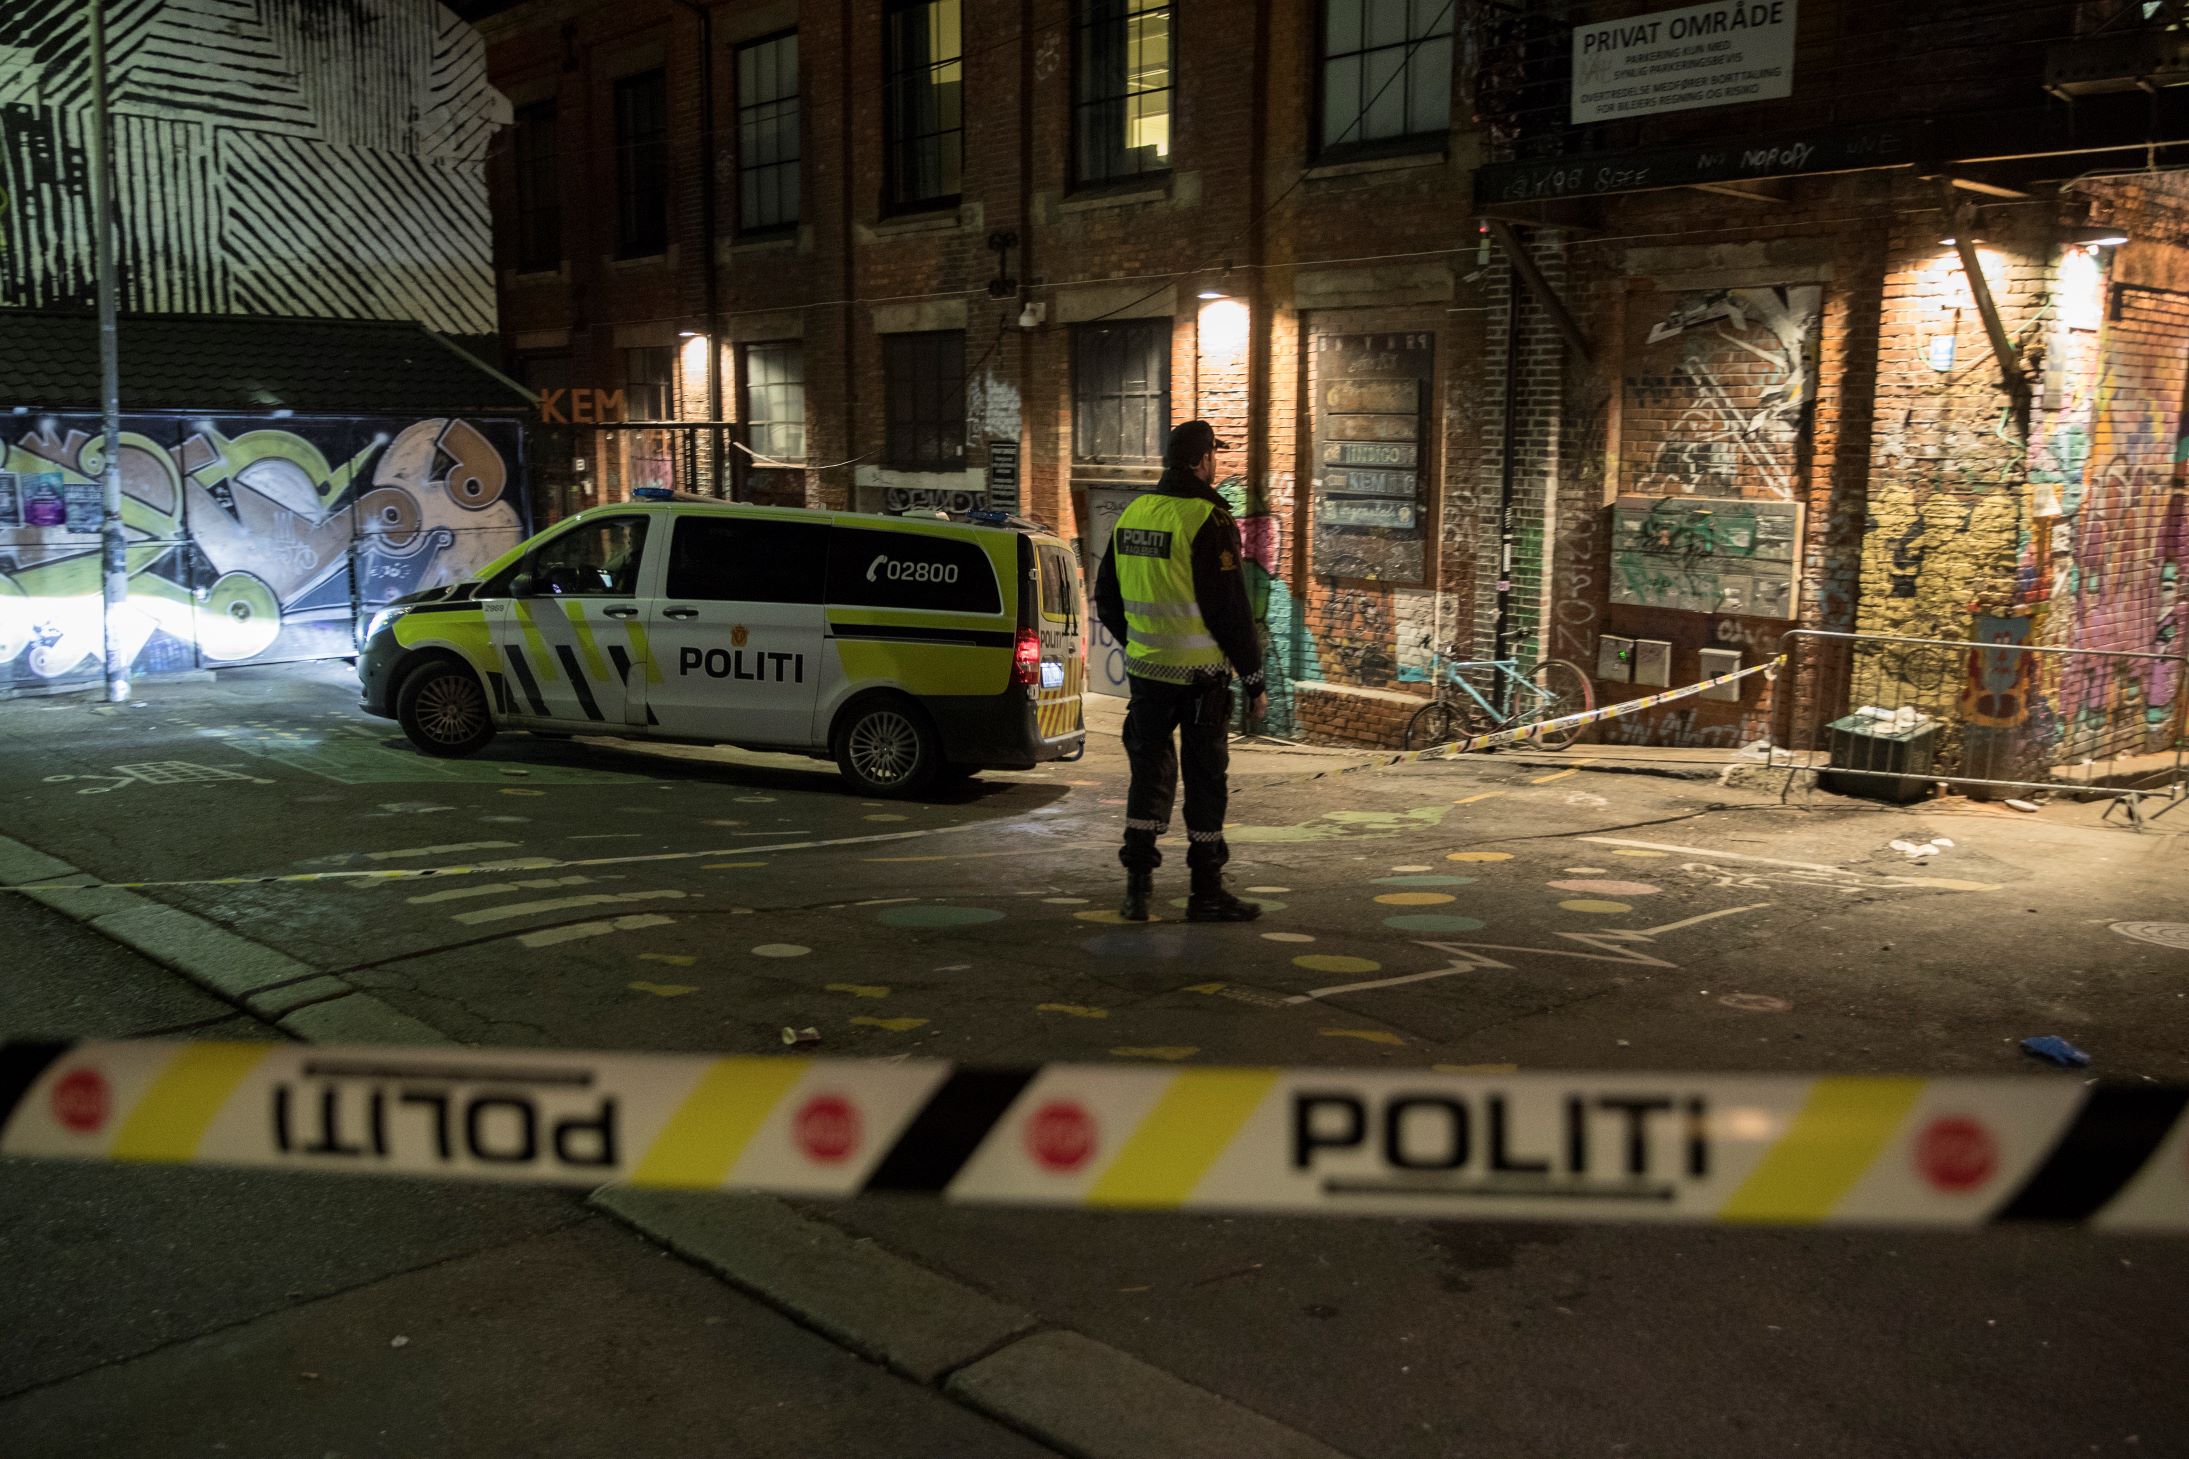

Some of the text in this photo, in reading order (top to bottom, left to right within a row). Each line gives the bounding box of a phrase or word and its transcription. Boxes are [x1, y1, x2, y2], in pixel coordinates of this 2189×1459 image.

[1584, 1, 1783, 53] PRIVAT OMRÅDE
[1614, 53, 1743, 80] SYNLIG PARKERINGSBEVIS
[1625, 40, 1731, 64] PARKERING KUN MED
[1580, 85, 1651, 104] OVERTREDELSE
[1653, 76, 1708, 93] MEDFØRER
[1596, 102, 1614, 114] FOR
[1659, 91, 1703, 106] REGNING
[1706, 88, 1723, 99] OG
[1725, 84, 1760, 98] RISIKO
[541, 387, 627, 423] KEM
[1123, 529, 1165, 547] POLITI
[887, 561, 959, 584] 02800
[1040, 630, 1062, 649] POLITI
[680, 646, 804, 683] POLITI
[274, 1085, 617, 1167] POLITI
[1293, 1093, 1707, 1177] POLITI
